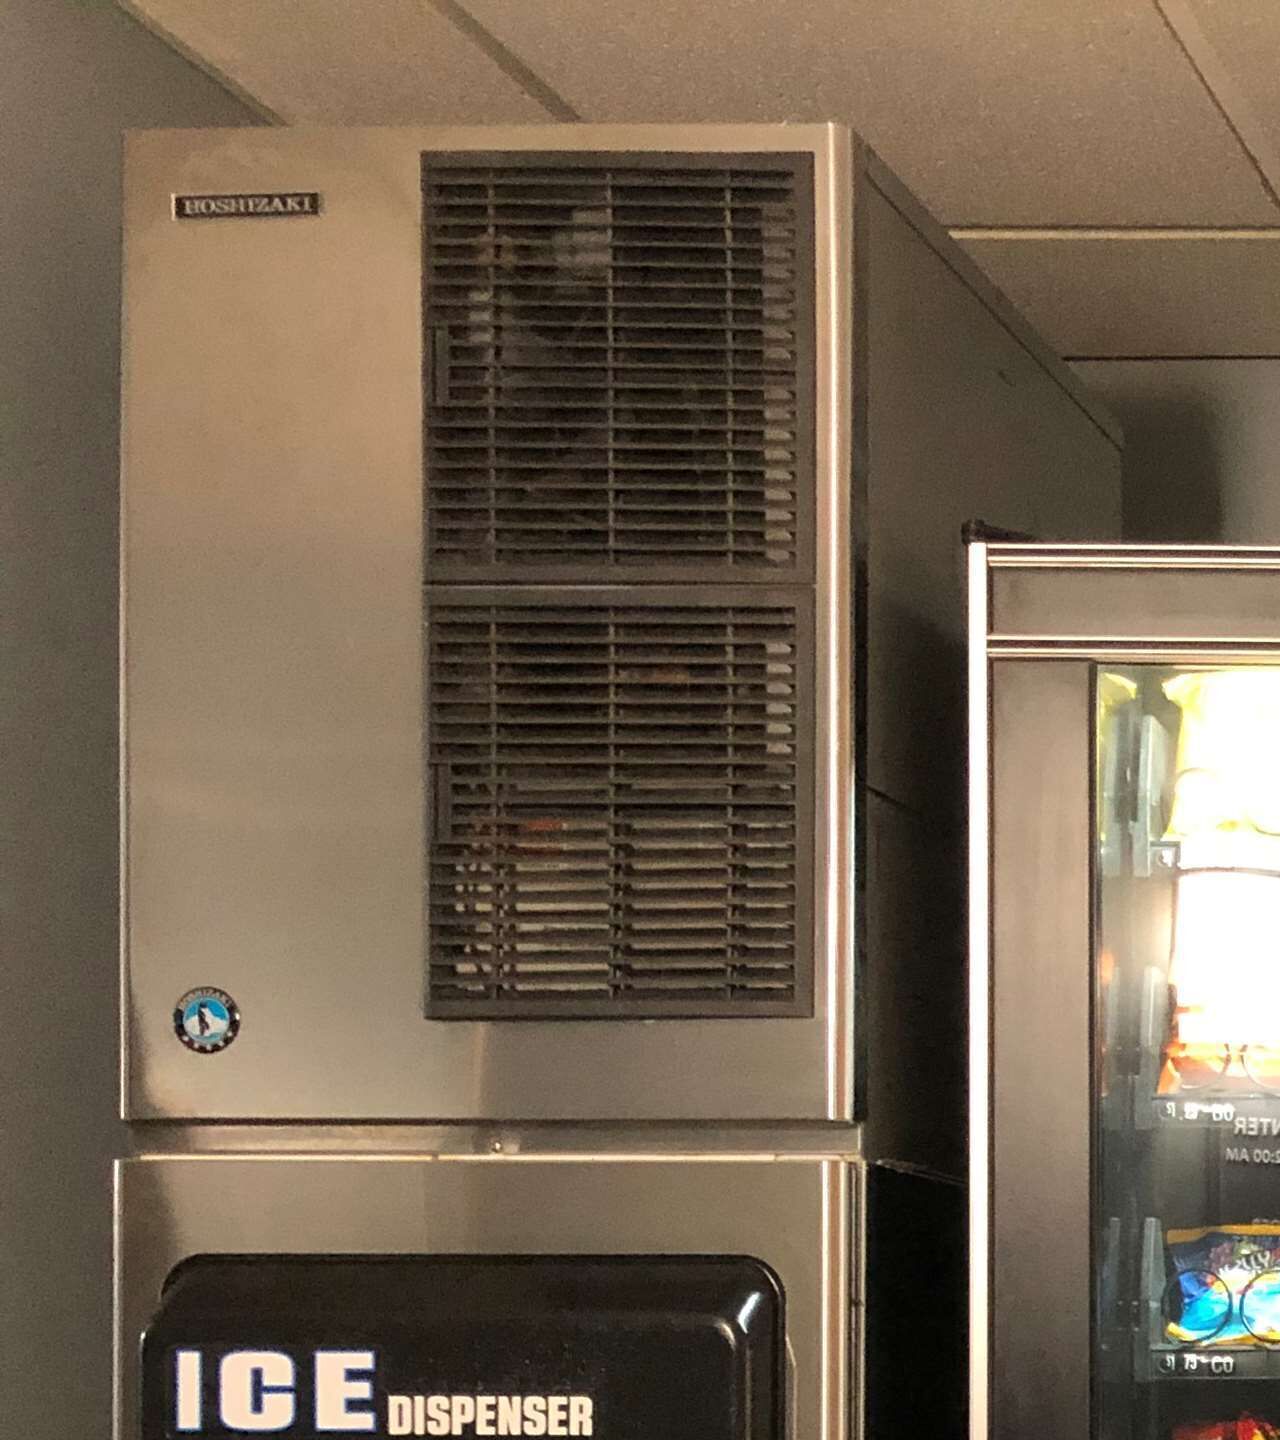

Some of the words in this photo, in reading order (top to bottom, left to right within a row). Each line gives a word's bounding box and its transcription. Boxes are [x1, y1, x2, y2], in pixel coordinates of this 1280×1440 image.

[184, 197, 313, 215] HOSHIZAKI
[1210, 1356, 1234, 1373] C0
[174, 1349, 378, 1432] ICE
[387, 1394, 594, 1437] DISPENSER
